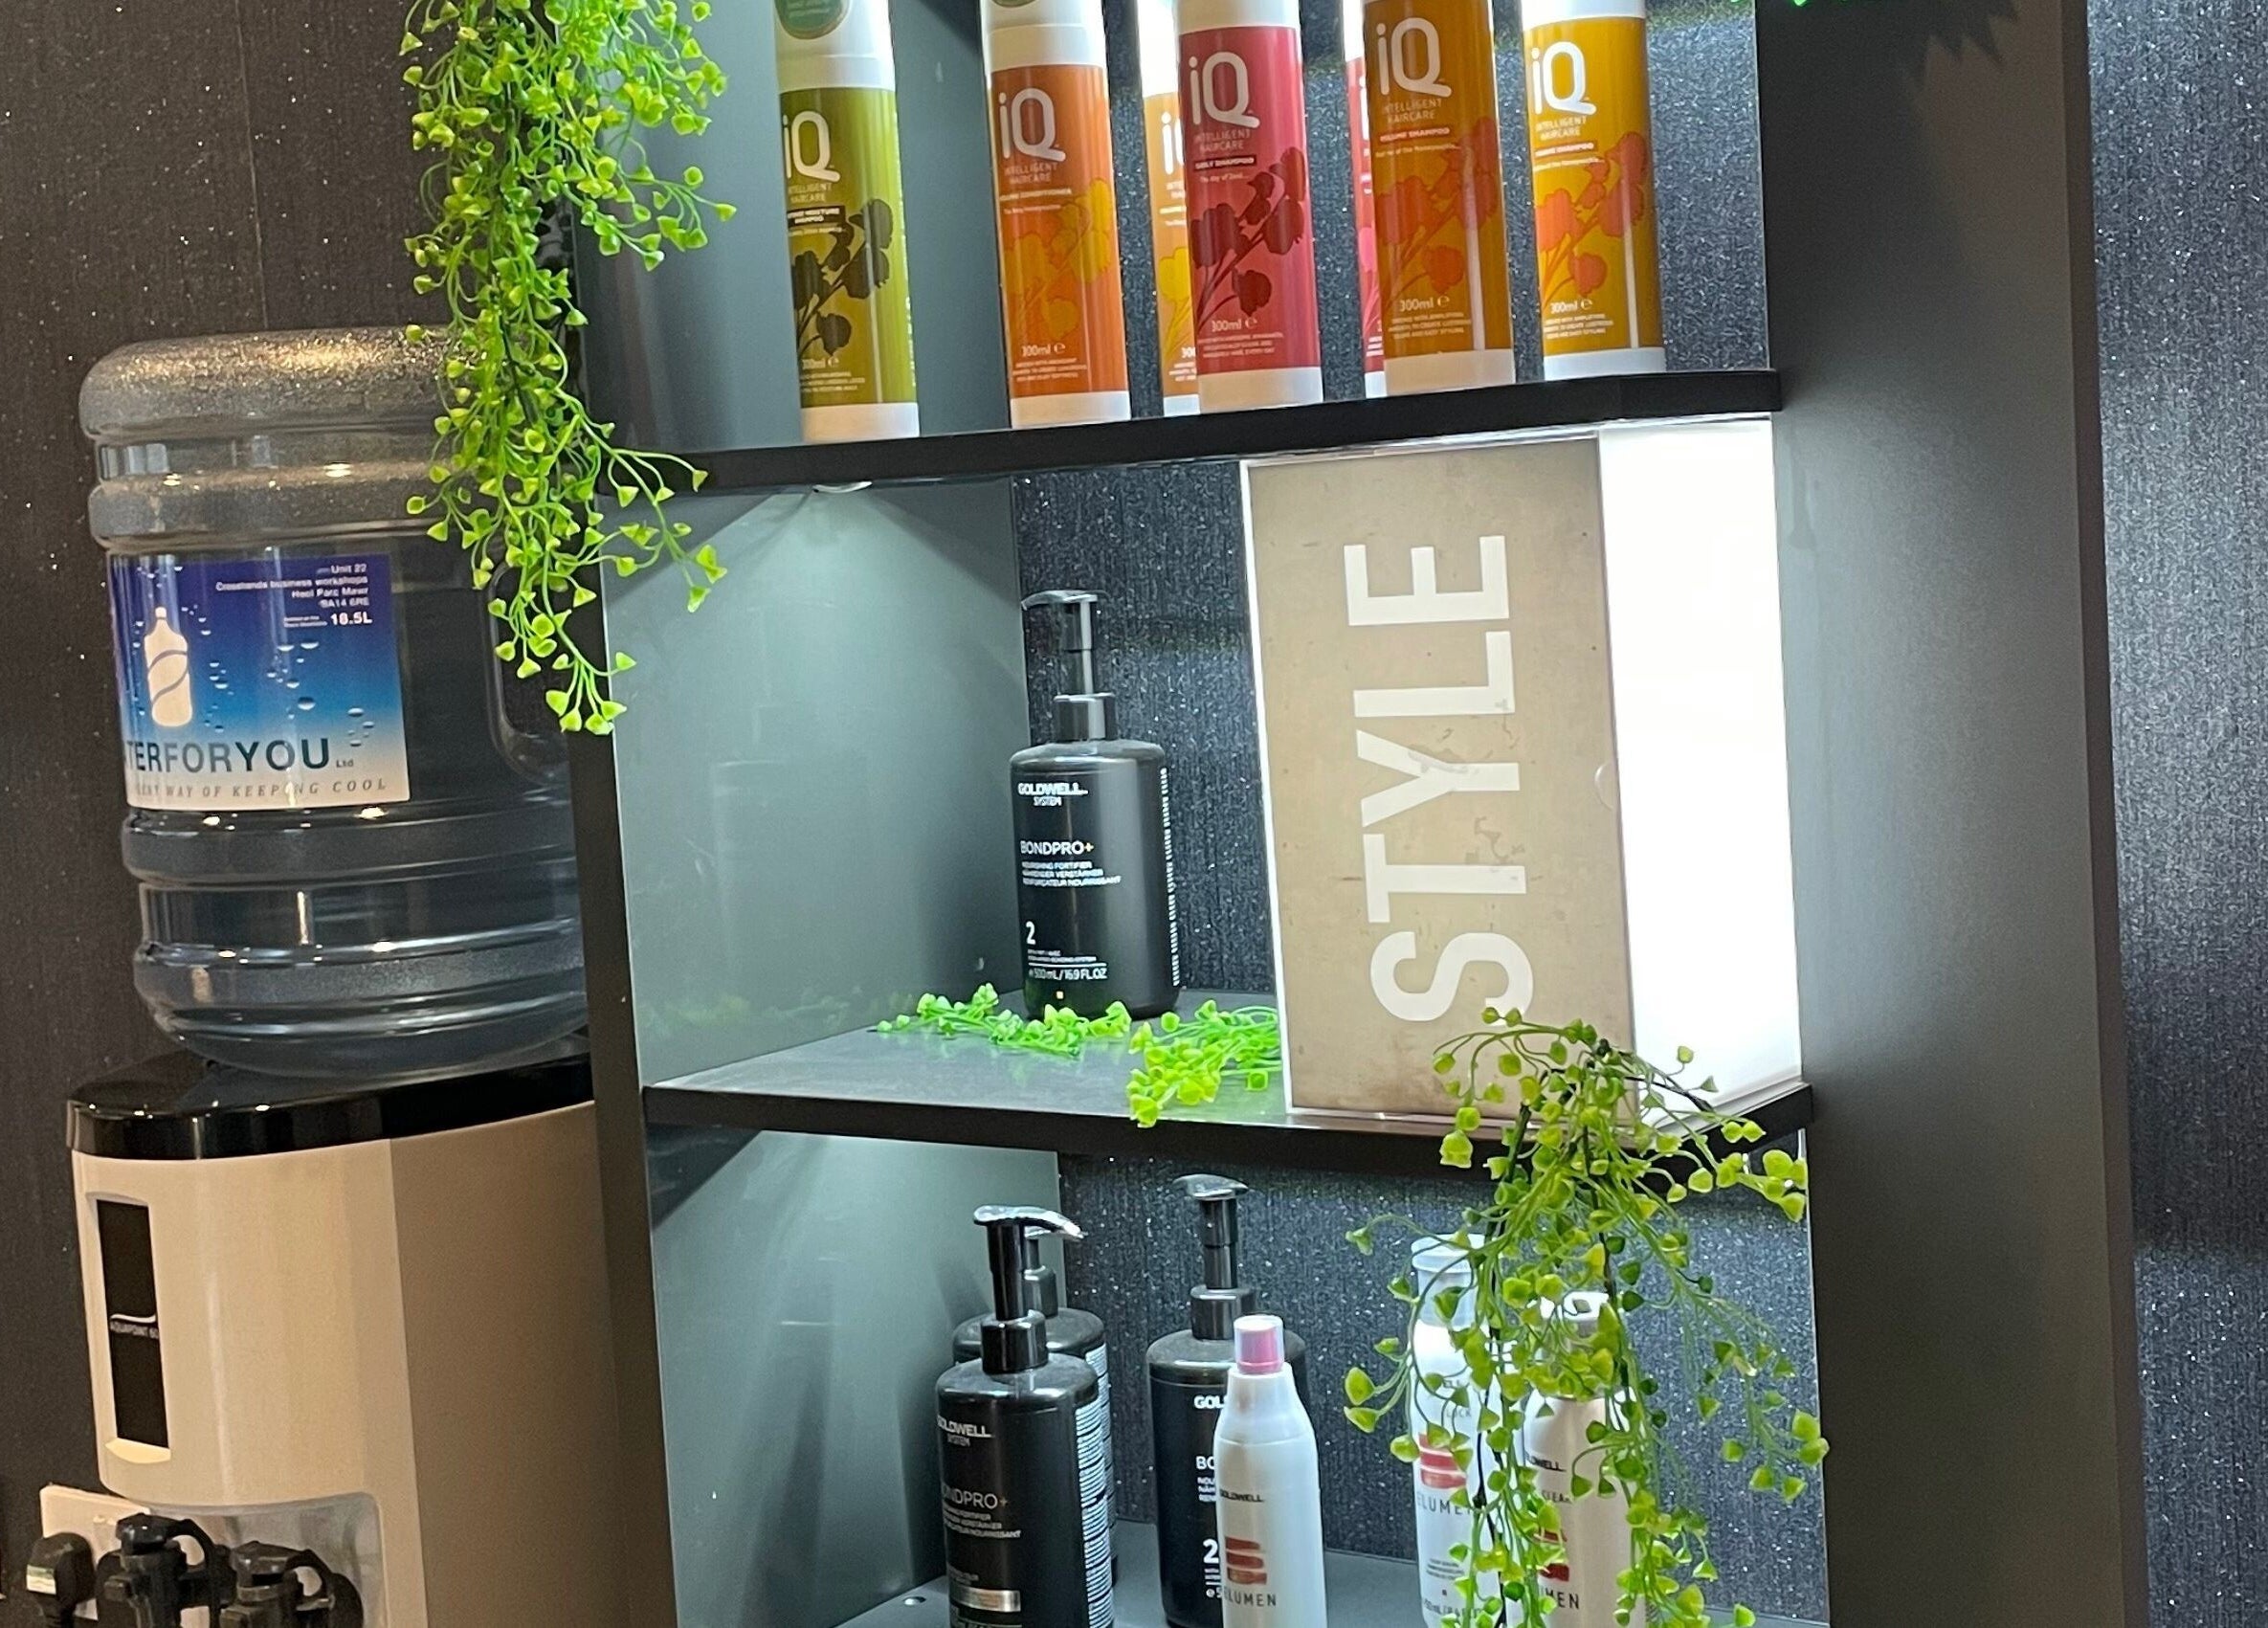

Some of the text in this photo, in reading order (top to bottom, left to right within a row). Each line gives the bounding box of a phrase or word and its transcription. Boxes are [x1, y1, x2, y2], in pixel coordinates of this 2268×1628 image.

[1376, 17, 1453, 98] iQ
[1531, 41, 1597, 115] iQ
[1189, 51, 1261, 129] iQ
[782, 110, 841, 183] iQ
[999, 88, 1066, 162] iQ
[167, 784, 193, 797] WAY
[202, 784, 222, 797] OF
[233, 780, 320, 797] KEEPING
[332, 777, 388, 794] COOL
[336, 758, 354, 769] Ltd
[1017, 781, 1089, 795] GOLDWELL
[1344, 535, 1535, 1028] STYLE
[1020, 840, 1095, 856] BONDPRO+
[1026, 921, 1036, 946] 2
[1203, 1538, 1220, 1564] 2
